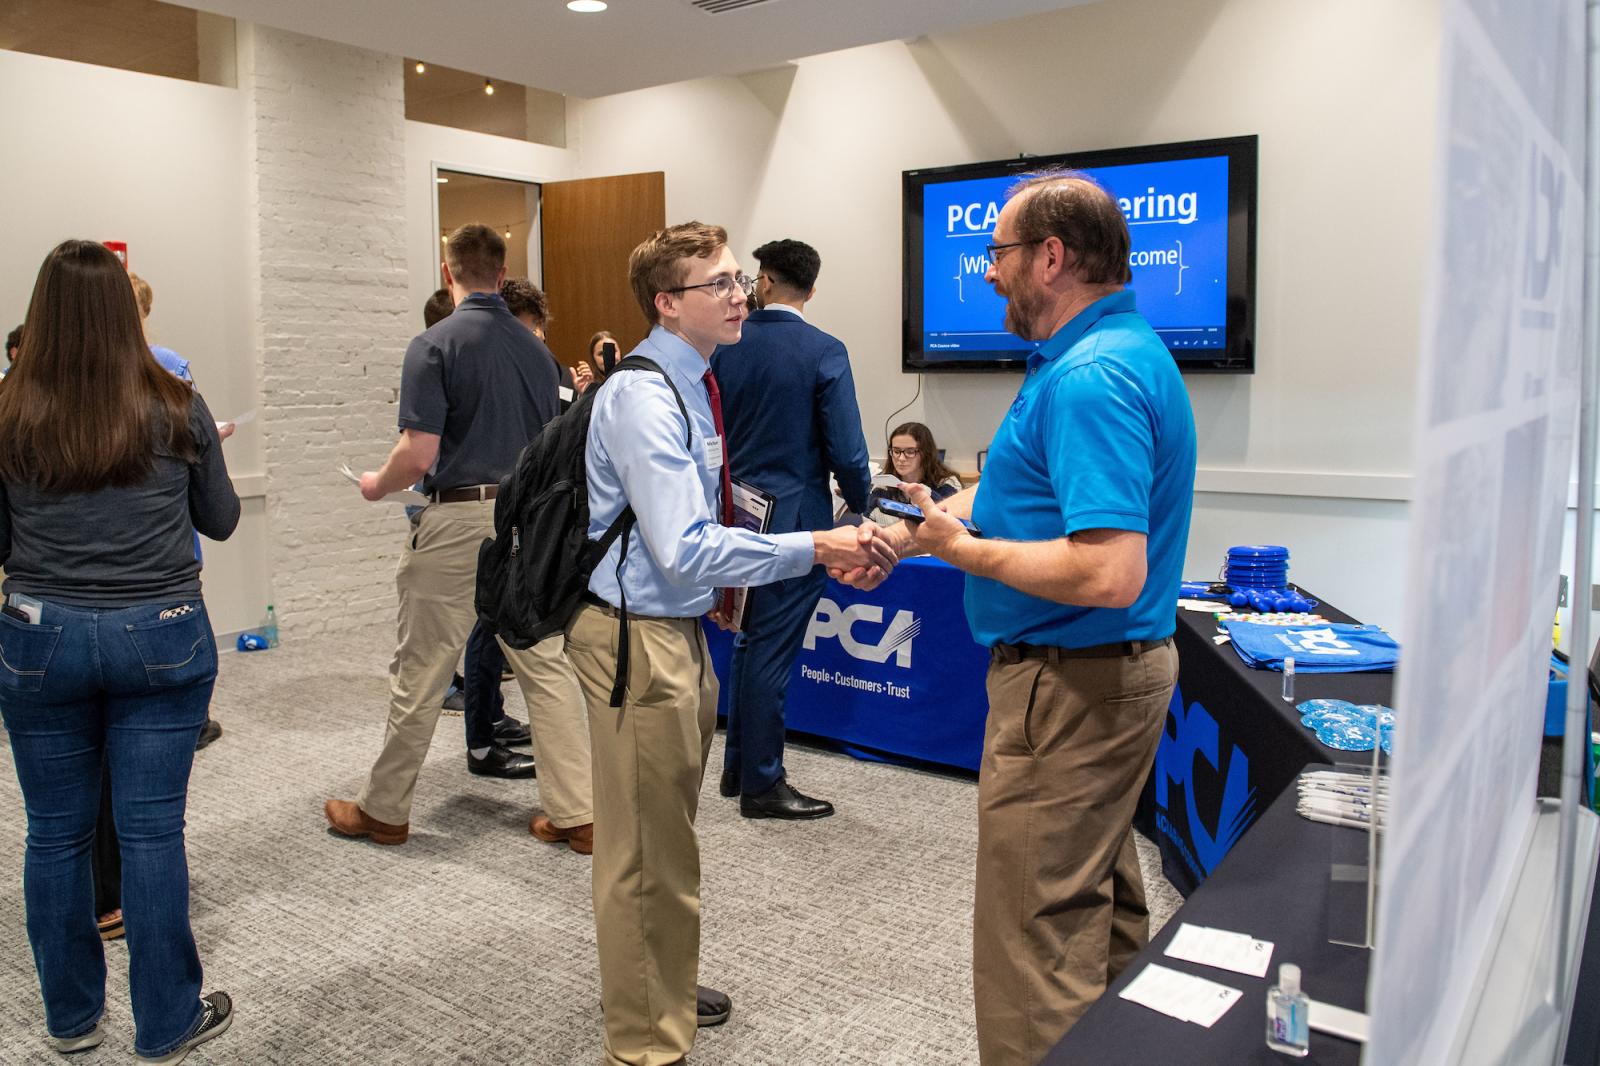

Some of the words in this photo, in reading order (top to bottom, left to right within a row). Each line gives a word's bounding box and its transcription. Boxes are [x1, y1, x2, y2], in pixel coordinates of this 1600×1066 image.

[948, 202, 999, 233] PCA
[1119, 187, 1197, 225] ering
[964, 255, 990, 274] Wh
[802, 597, 919, 669] PCA
[802, 664, 830, 684] People
[835, 672, 882, 693] Customers
[886, 681, 911, 699] Trust
